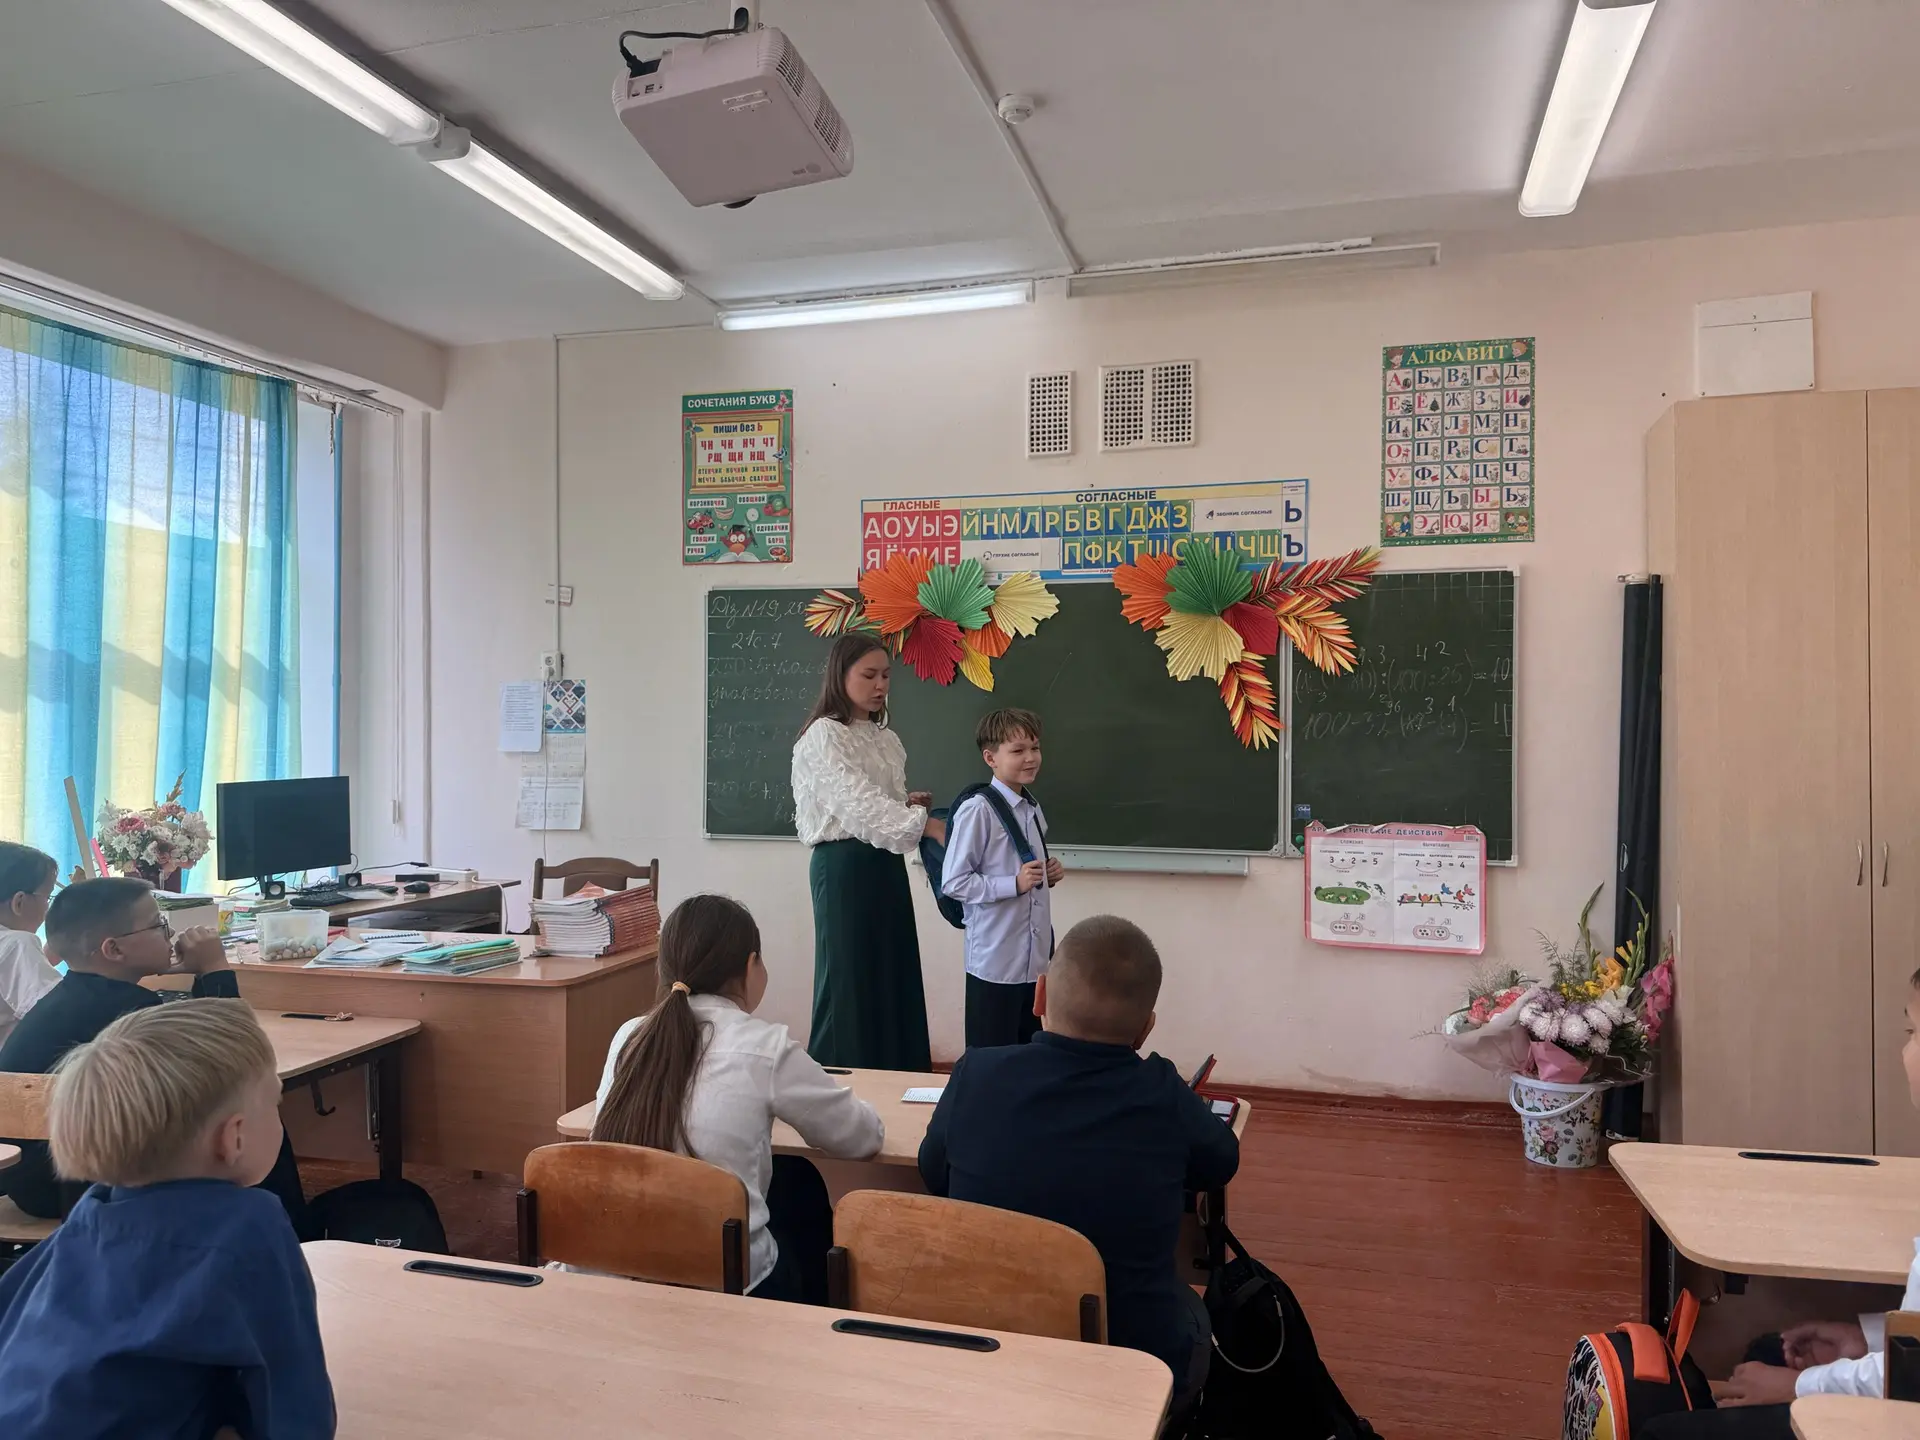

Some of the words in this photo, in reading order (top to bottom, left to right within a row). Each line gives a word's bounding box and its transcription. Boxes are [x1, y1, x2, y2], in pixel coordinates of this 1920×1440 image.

[1406, 345, 1508, 365] АЛФАВИТ
[1388, 372, 1401, 386] А
[1418, 370, 1430, 384] Б
[1447, 368, 1459, 382] В
[1476, 366, 1488, 380] Г
[1505, 365, 1519, 379] Д
[688, 397, 747, 408] СОЧЕТАНИЯ
[749, 394, 776, 405] БУКВ
[1389, 396, 1400, 411] Е
[1417, 393, 1428, 409] Ё
[1446, 392, 1461, 407] Ж
[1476, 391, 1486, 405] З
[1505, 389, 1518, 404] И
[713, 424, 738, 434] пиши
[740, 422, 755, 432] без
[1388, 417, 1401, 434] Й
[1416, 418, 1430, 432] К
[1445, 416, 1459, 430] Л
[1475, 414, 1490, 429] М
[1505, 413, 1518, 428] Н
[763, 437, 774, 447] ЧТ
[1387, 444, 1402, 458] О
[1416, 442, 1428, 456] П
[1447, 440, 1458, 455] Р
[1475, 439, 1488, 454] С
[1505, 438, 1518, 452] Т
[708, 453, 722, 463] РЩ
[1387, 468, 1401, 483] У
[1415, 467, 1432, 481] Ф
[1445, 465, 1458, 479] Х
[1475, 464, 1488, 480] Ц
[1505, 462, 1518, 477] Ч
[1076, 490, 1157, 502] СОГЛАСНЫЕ
[1386, 492, 1400, 506] Ш
[1415, 491, 1432, 506] Щ
[1444, 490, 1459, 504] Ъ
[1474, 488, 1490, 503] Ы
[1505, 488, 1518, 502] Ь
[883, 500, 941, 511] ГЛАСНЫЕ
[1285, 500, 1302, 522] Ь
[1415, 515, 1428, 529] Э
[1444, 514, 1462, 528] Ю
[1475, 512, 1488, 527] Я
[1283, 534, 1304, 557] Ъ
[1435, 641, 1451, 656] 2
[1395, 825, 1443, 836] ДЕЙСТВИЯ
[1329, 856, 1335, 864] 3
[1373, 857, 1378, 865] 5
